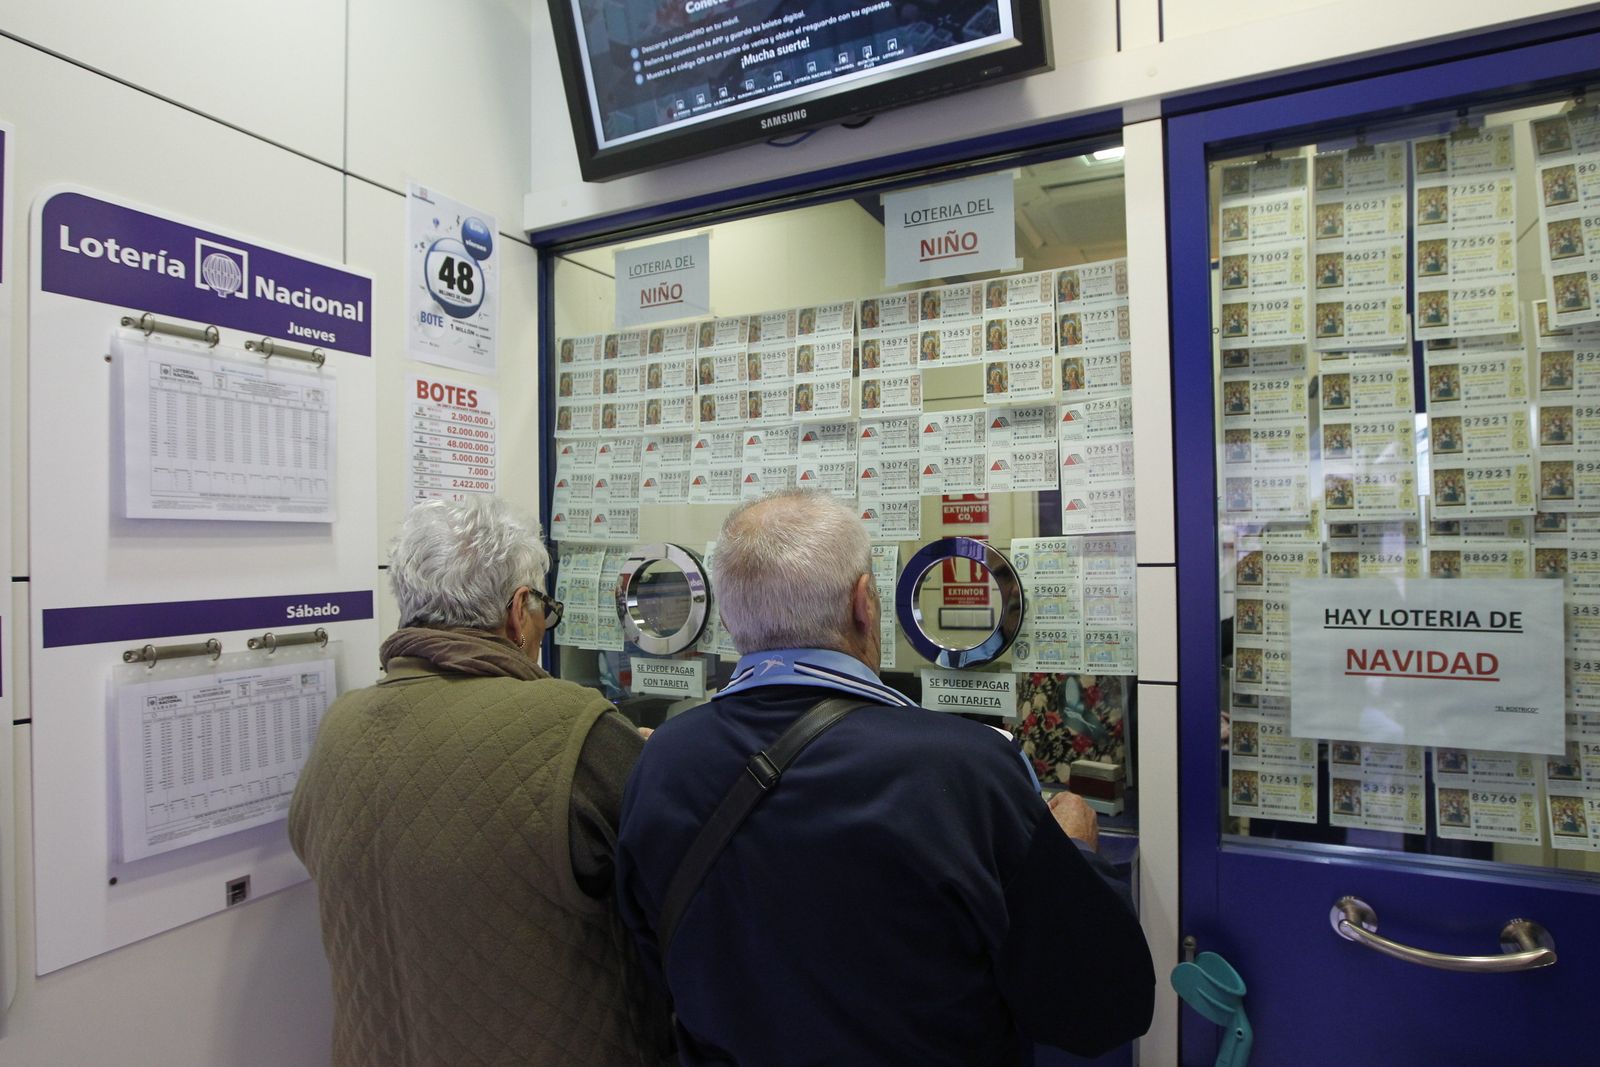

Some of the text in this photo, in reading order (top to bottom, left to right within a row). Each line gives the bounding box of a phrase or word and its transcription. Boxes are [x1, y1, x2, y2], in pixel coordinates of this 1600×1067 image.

[838, 12, 850, 21] con
[777, 36, 810, 56] suerte!
[760, 109, 807, 130] SAMSUNG
[904, 198, 994, 225] LOTERIA DEL
[1250, 201, 1289, 215] 71002
[920, 230, 979, 258] NIÑO
[1250, 251, 1290, 264] 71002
[629, 255, 695, 277] LOTERIA DEL
[60, 224, 363, 322] Lotería Nacional
[439, 255, 475, 295] 48
[640, 281, 683, 305] NIÑO
[1250, 300, 1290, 312] 71002
[420, 311, 444, 328] BOTE
[1084, 310, 1115, 320] 17751
[1009, 316, 1039, 326] 16632
[287, 321, 335, 343] Jueves
[1010, 360, 1040, 369] 16632
[1086, 355, 1118, 366] 17751
[1462, 362, 1506, 375] 97921
[1352, 373, 1394, 385] 52210
[1252, 380, 1290, 391] 25829
[416, 380, 478, 408] BOTES
[1086, 401, 1118, 410] 07541
[944, 414, 974, 423] 21573
[1013, 408, 1044, 418] 16632
[881, 419, 908, 429] 13074
[1464, 415, 1509, 428] 97921
[447, 426, 489, 439] 62.000.000
[1253, 429, 1291, 439] 25829
[1354, 424, 1395, 434] 52210
[447, 440, 489, 452] 48.000.000
[1086, 445, 1119, 454] 07541
[944, 456, 974, 465] 21573
[1013, 452, 1044, 461] 16632
[881, 461, 908, 470] 13074
[1466, 468, 1512, 480] 97921
[1253, 478, 1292, 488] 25829
[1088, 491, 1122, 500] 07541
[881, 502, 908, 511] 13074
[943, 505, 987, 514] EXTINTOR
[1035, 542, 1067, 551] 55602
[1085, 542, 1117, 550] 07541
[1265, 553, 1304, 562] 06038
[1463, 552, 1508, 563] 88692
[947, 587, 984, 596] EXTINTOR
[1034, 586, 1067, 594] 55602
[1085, 586, 1118, 594] 07541
[286, 602, 340, 619] Sábado
[1325, 608, 1522, 629] HAY LOTERIA DE
[1035, 631, 1067, 639] 55602
[1085, 633, 1119, 641] 07541
[1346, 648, 1499, 676] NAVIDAD
[637, 664, 695, 675] SE PUEDE PAGAR
[643, 678, 689, 688] CON TARJETA
[929, 678, 1010, 691] SE PUEDE PAGAR
[938, 694, 1002, 706] CON TARJETA
[1260, 774, 1299, 784] 07541
[1472, 792, 1517, 804] 86766
